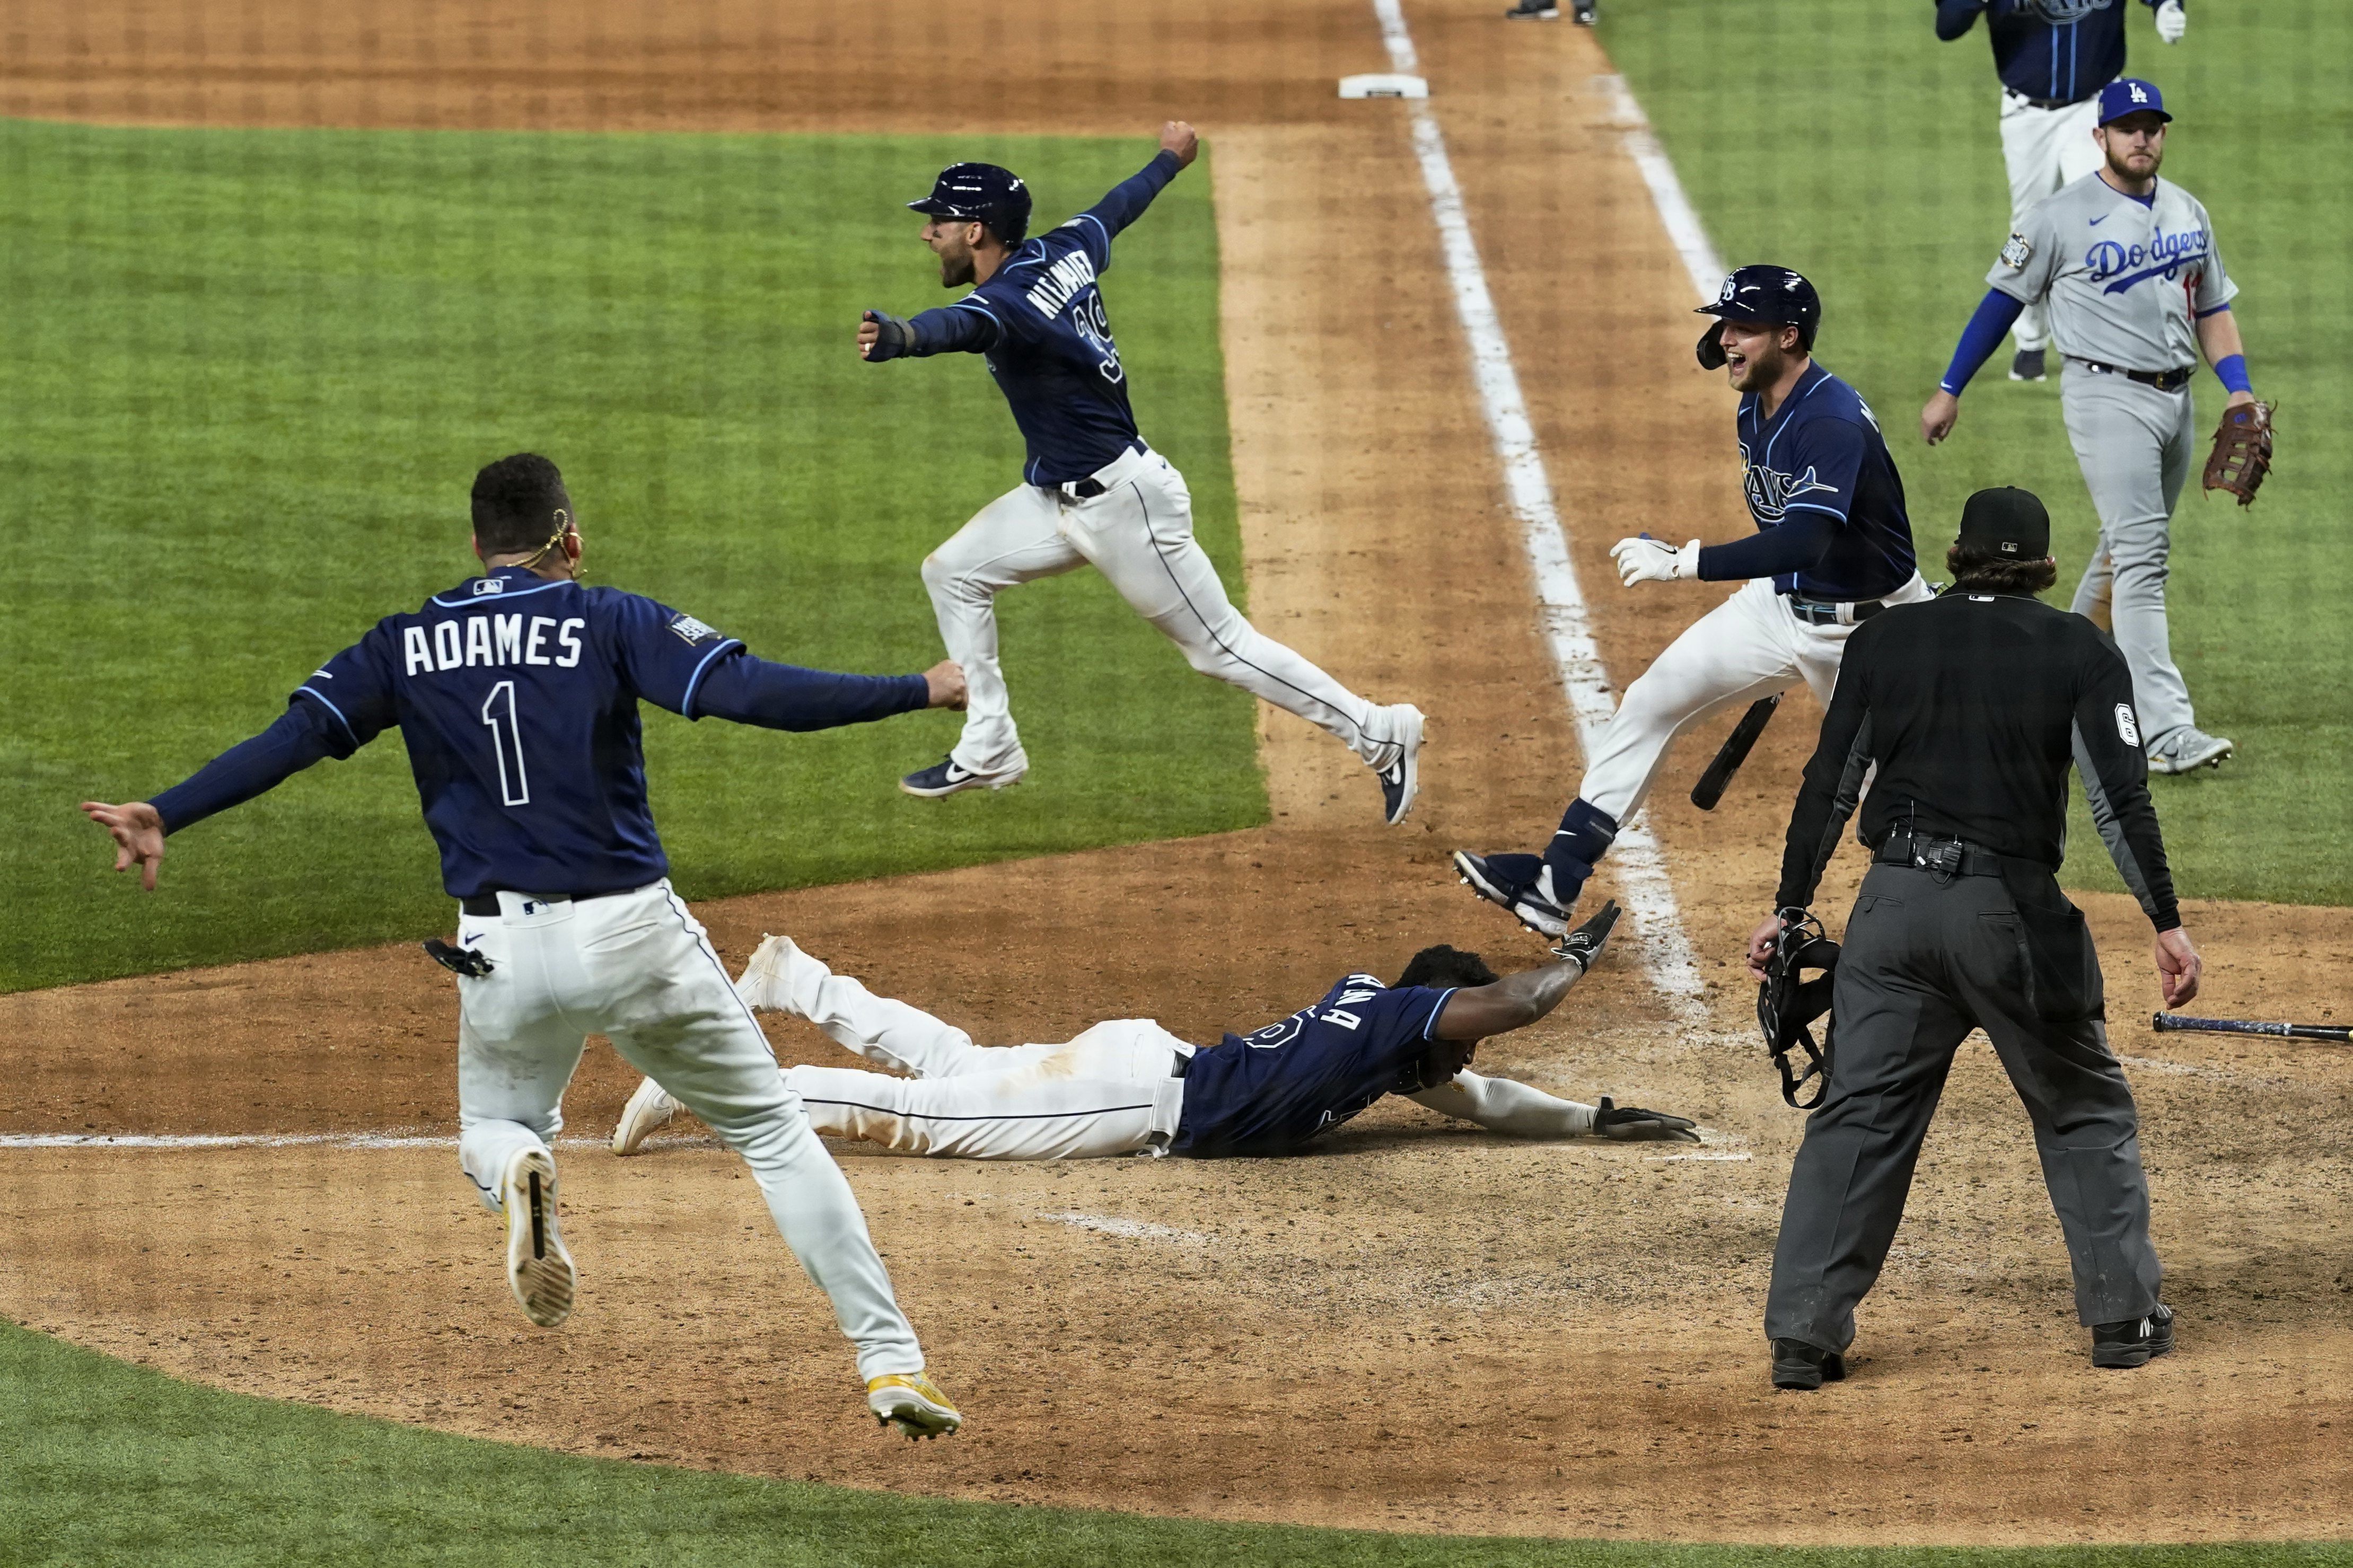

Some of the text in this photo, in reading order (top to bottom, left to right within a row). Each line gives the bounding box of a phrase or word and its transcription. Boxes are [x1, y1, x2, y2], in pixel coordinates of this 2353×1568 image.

[2128, 83, 2147, 103] LA
[404, 614, 584, 676] ADAMES
[482, 681, 529, 806] 1
[2114, 703, 2139, 747] 6
